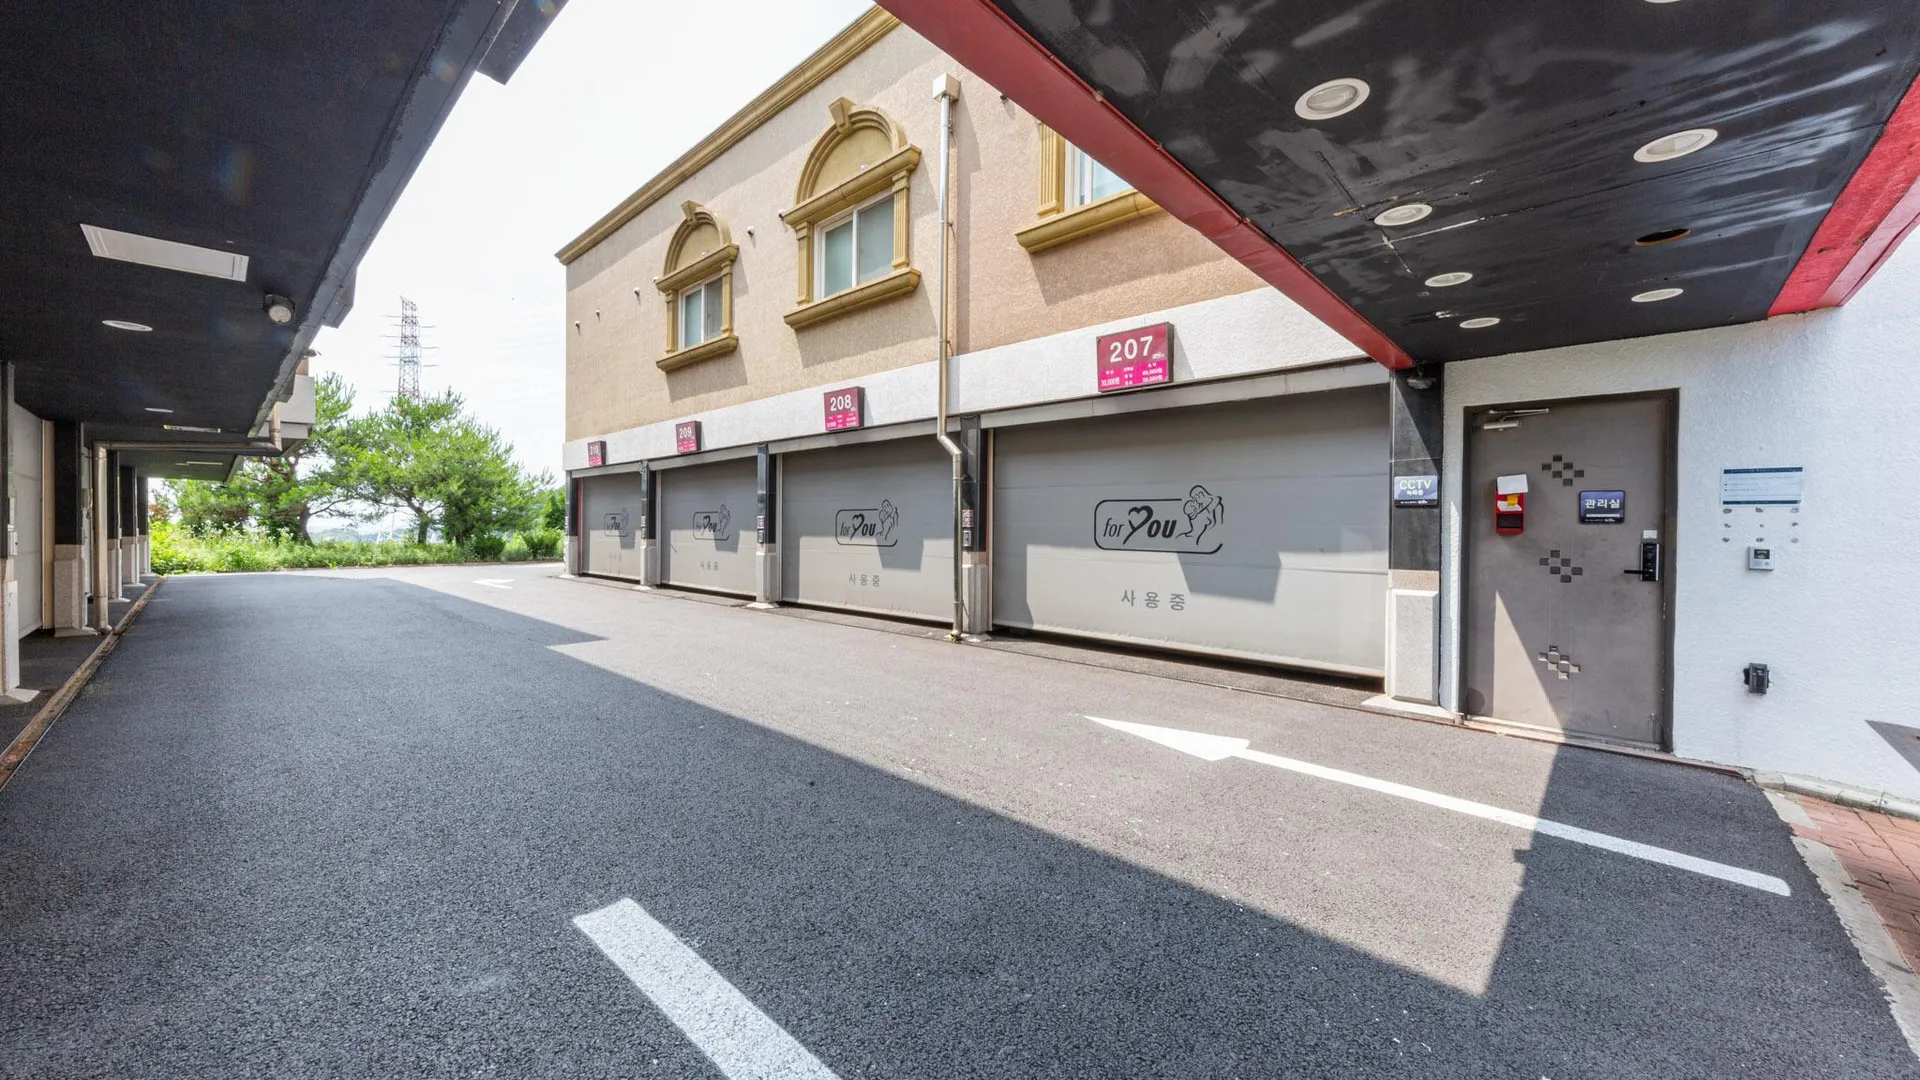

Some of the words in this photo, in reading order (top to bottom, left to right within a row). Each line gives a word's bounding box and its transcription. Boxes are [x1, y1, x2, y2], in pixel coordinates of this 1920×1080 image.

[1109, 335, 1153, 363] 207
[830, 394, 852, 412] 208
[679, 426, 692, 439] 209
[1399, 479, 1432, 490] CCTV
[1585, 498, 1620, 509] 관리실
[1103, 517, 1125, 538] for
[1123, 505, 1177, 545] You
[849, 573, 880, 588] 사용중
[1121, 589, 1185, 611] 사용중
